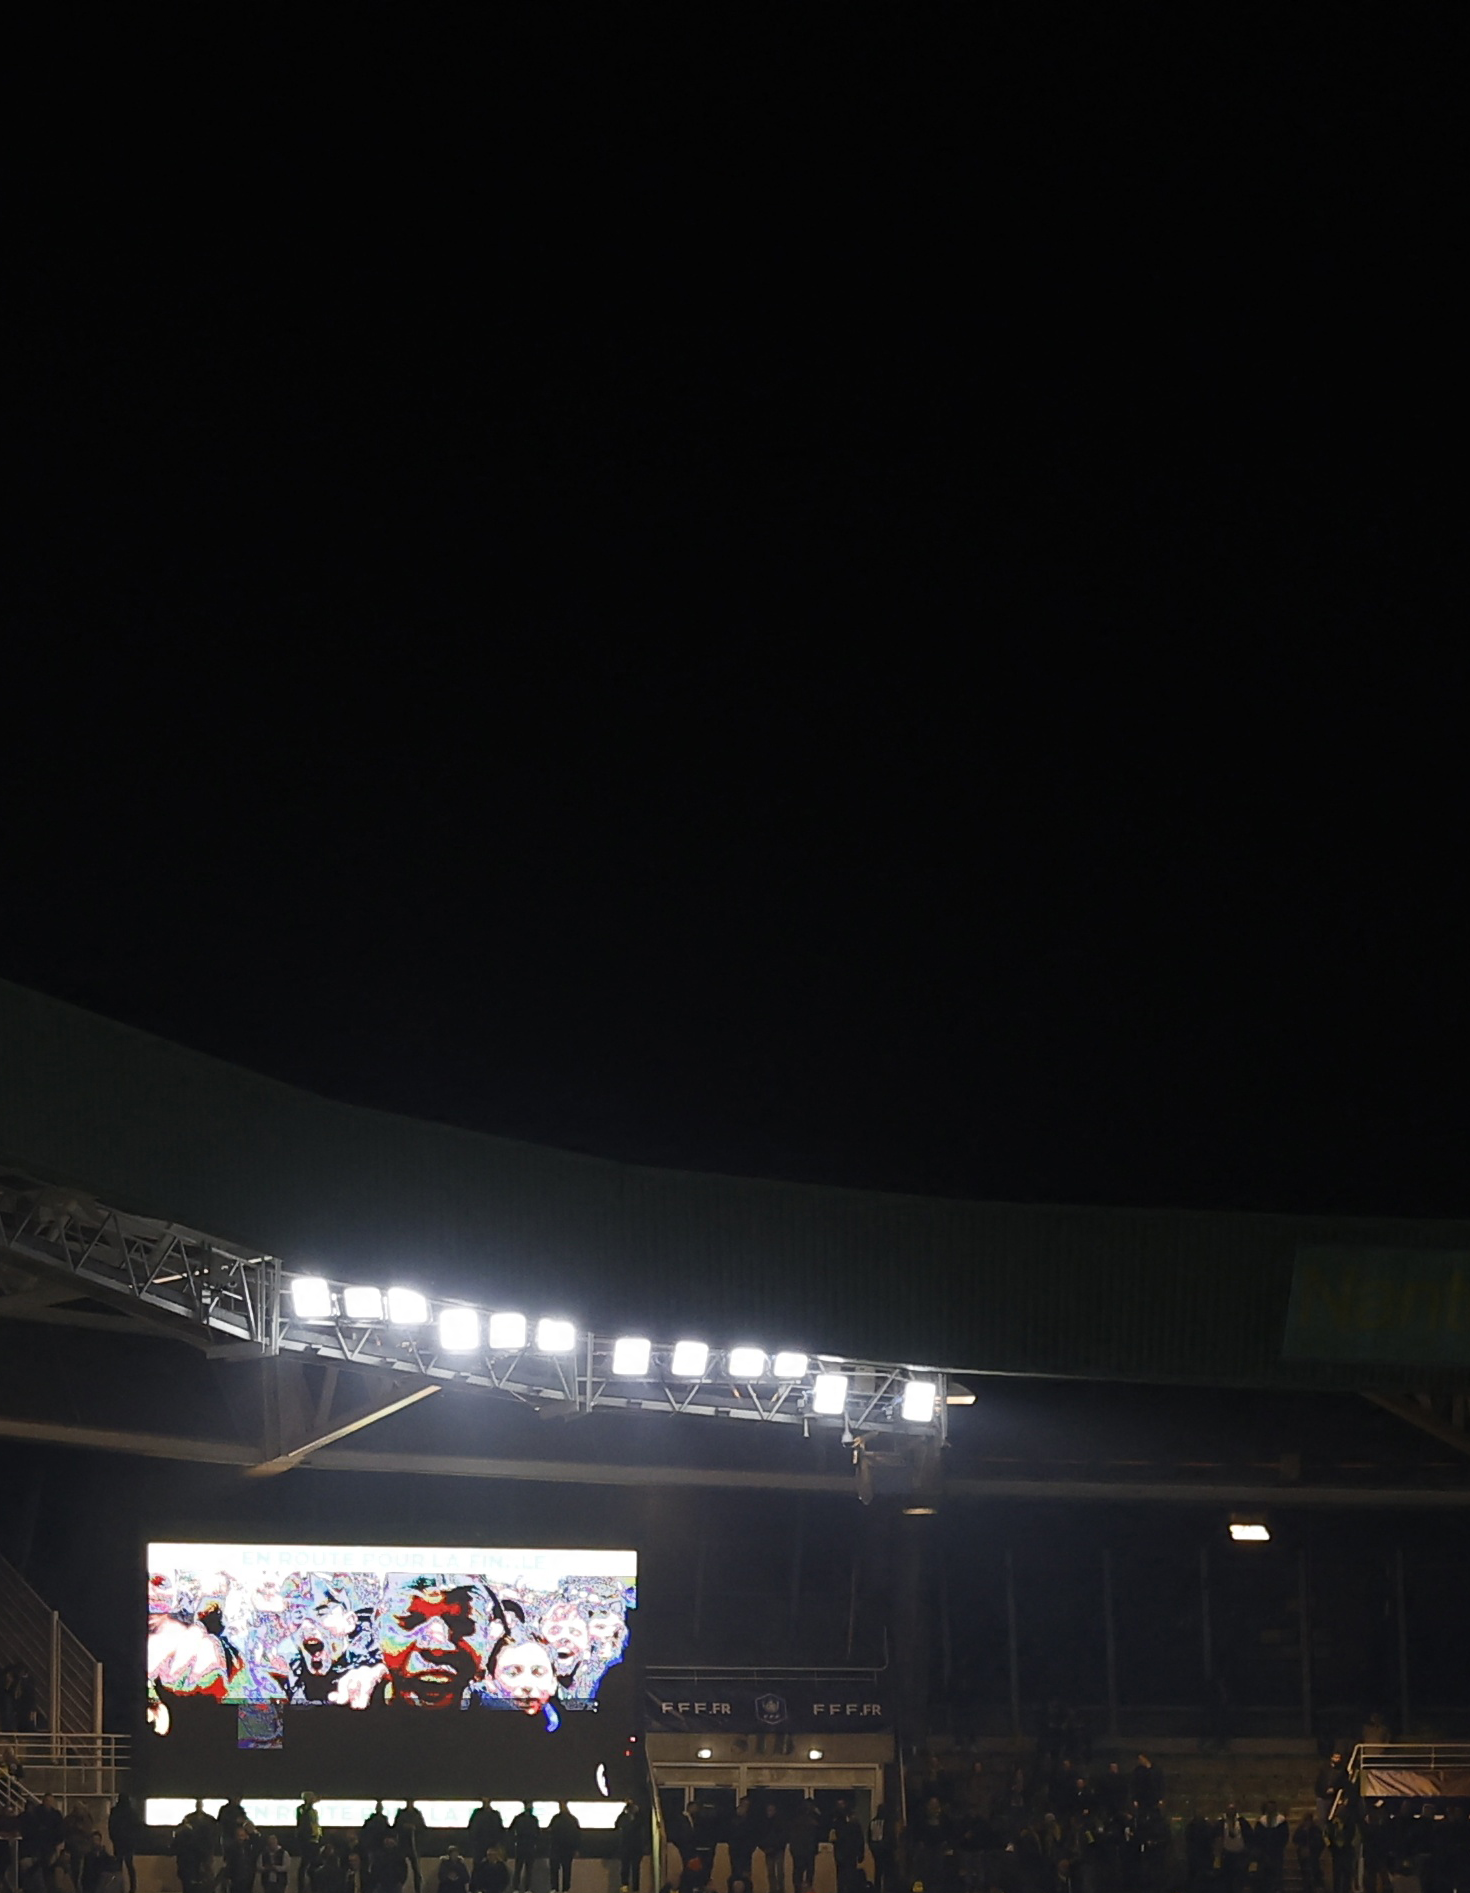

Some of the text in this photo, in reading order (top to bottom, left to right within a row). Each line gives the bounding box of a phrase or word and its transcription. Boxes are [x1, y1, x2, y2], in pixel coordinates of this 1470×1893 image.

[242, 1551, 547, 1570] EN ROUTE POUR LA FINLE
[661, 1702, 732, 1714] FFF.FR
[813, 1703, 882, 1716] FFF.FR
